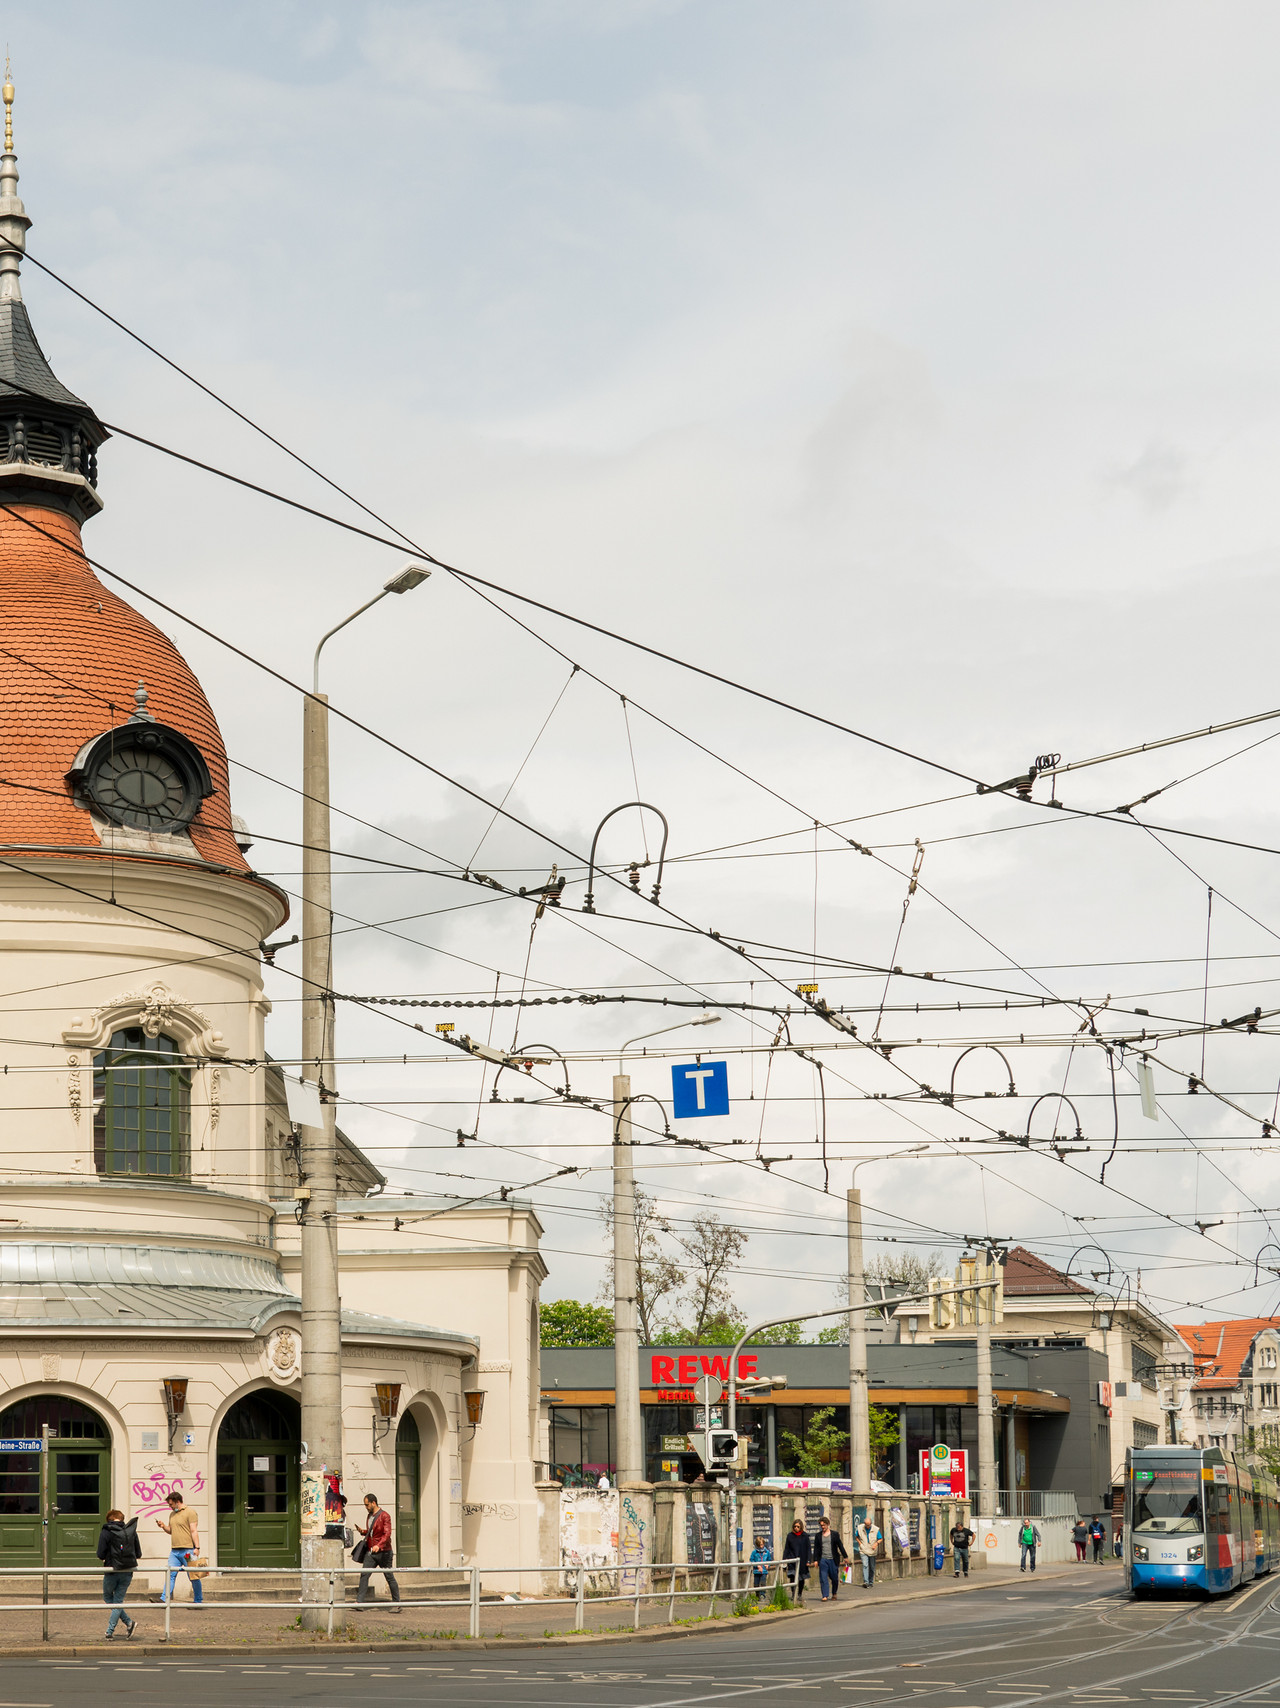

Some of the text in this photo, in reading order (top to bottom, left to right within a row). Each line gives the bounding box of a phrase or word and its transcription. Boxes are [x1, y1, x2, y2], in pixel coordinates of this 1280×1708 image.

[685, 1069, 714, 1110] T
[651, 1355, 760, 1384] REWE
[657, 1389, 695, 1402] Mandy
